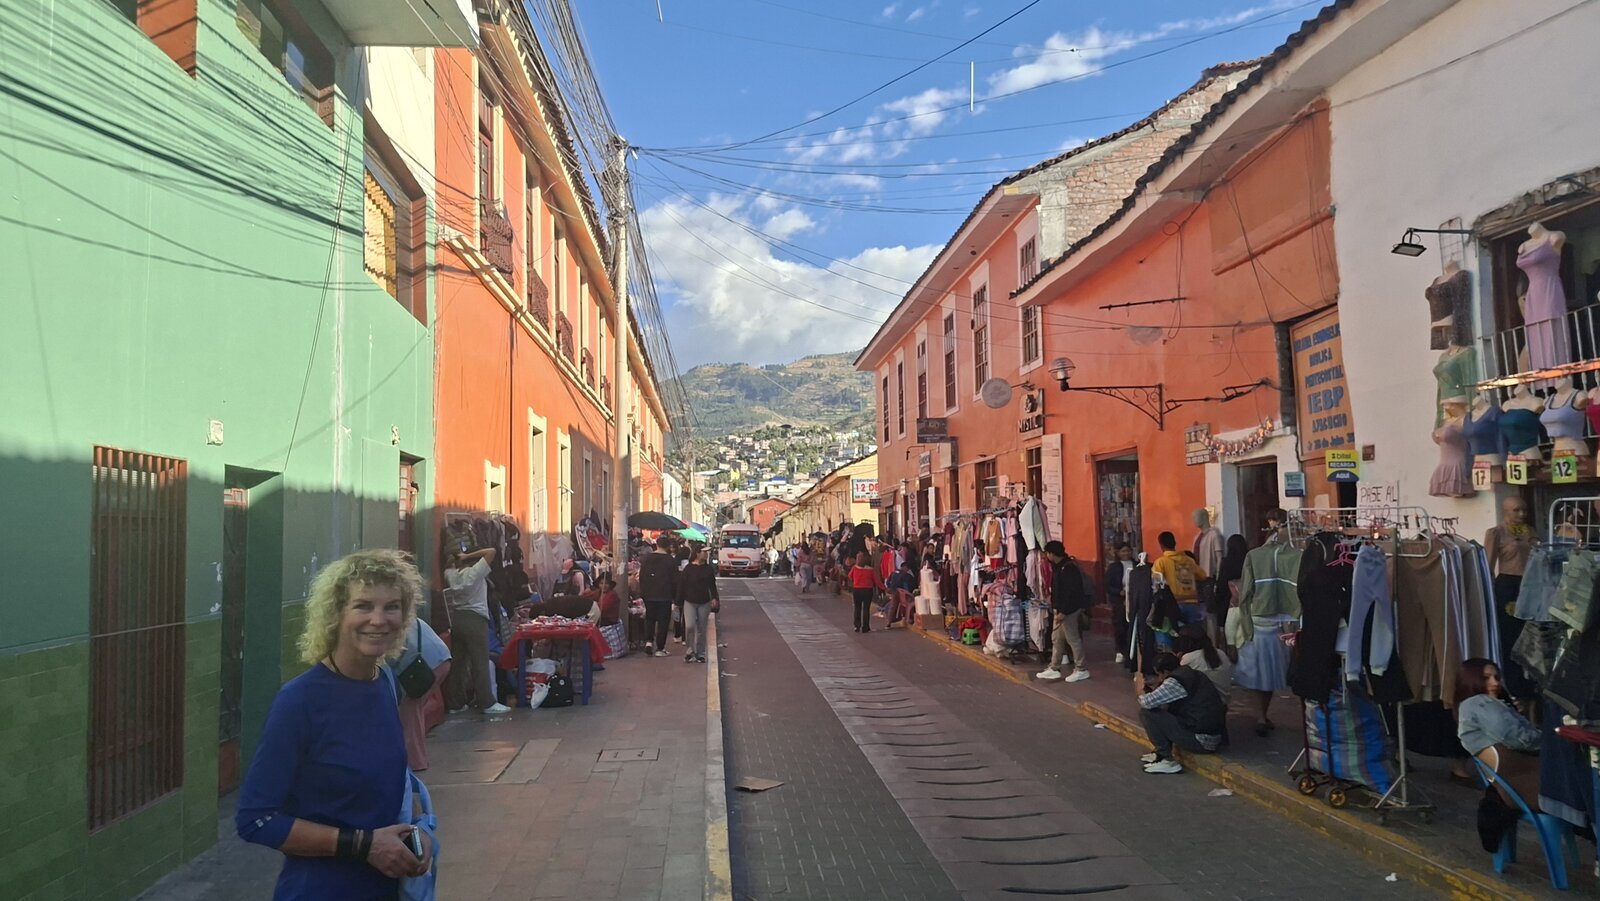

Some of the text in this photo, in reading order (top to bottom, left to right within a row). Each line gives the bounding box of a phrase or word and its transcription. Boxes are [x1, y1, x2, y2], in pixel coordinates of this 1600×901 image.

[1307, 386, 1344, 414] IEBP
[1475, 470, 1486, 486] 17
[1508, 463, 1522, 481] 15
[1555, 461, 1572, 478] 12
[1360, 485, 1397, 503] PASE AL
